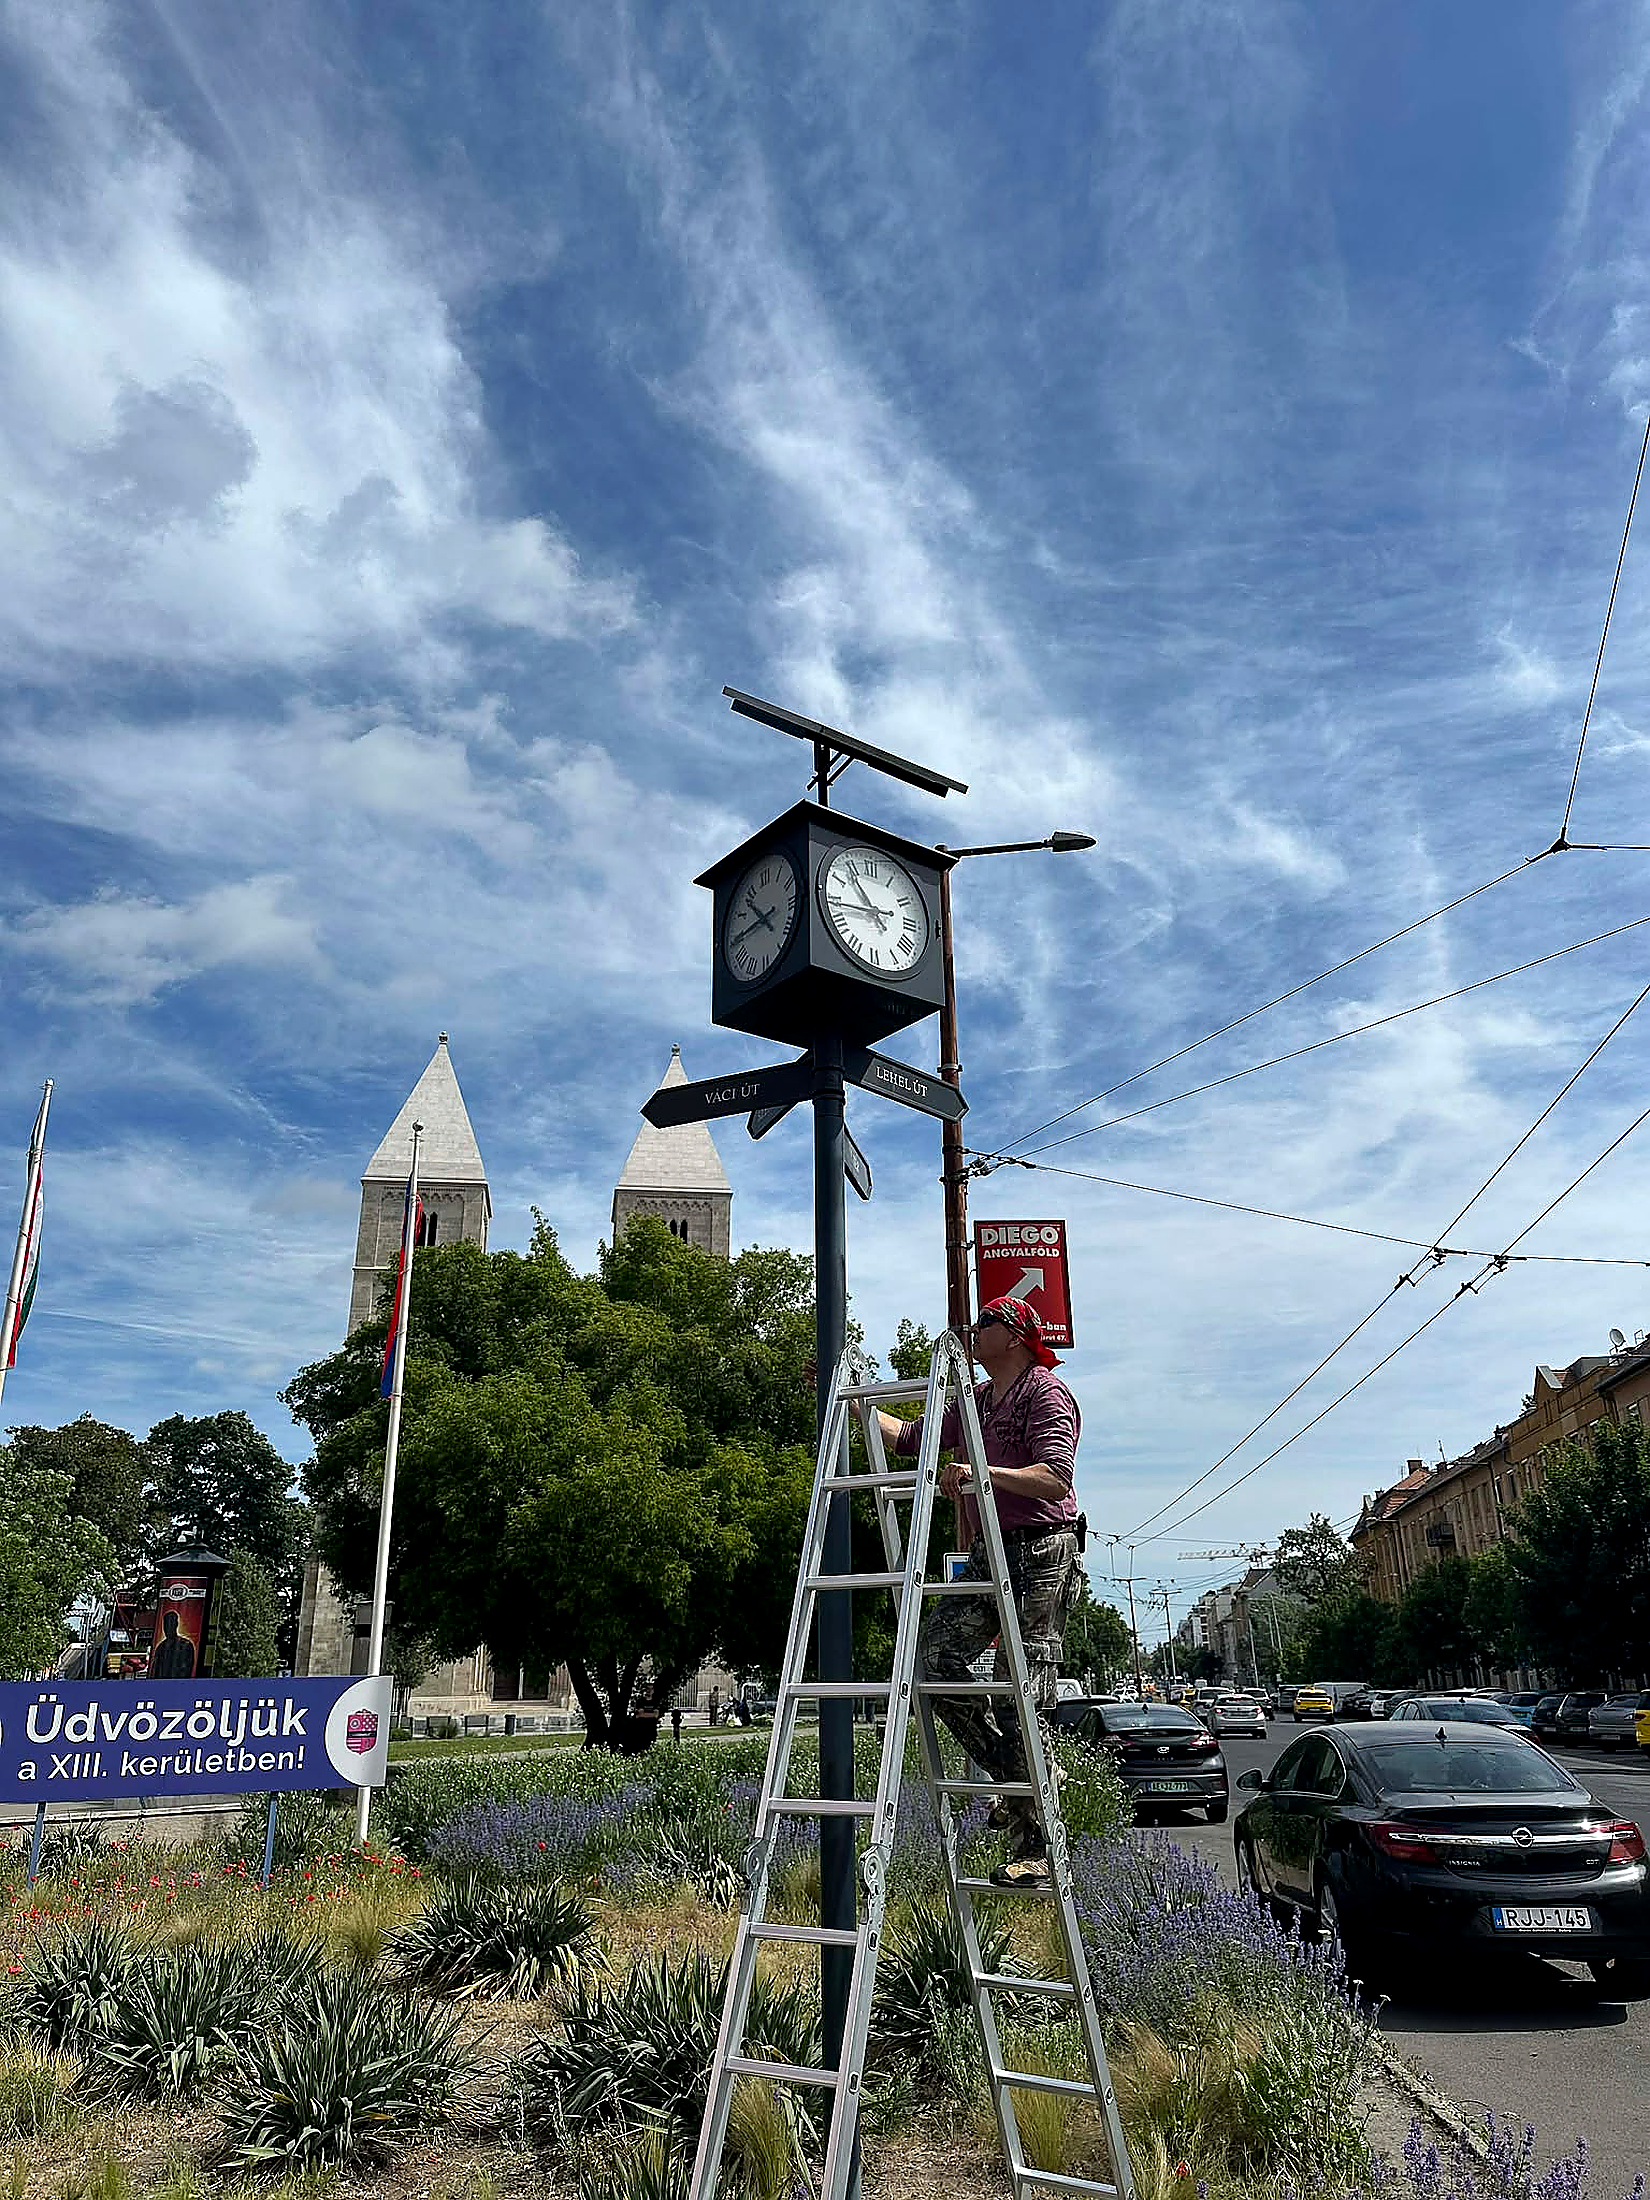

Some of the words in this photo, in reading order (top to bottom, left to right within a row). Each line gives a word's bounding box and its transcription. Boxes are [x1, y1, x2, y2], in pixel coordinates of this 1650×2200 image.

[902, 916, 918, 933] III
[875, 1066, 912, 1091] LEHEL
[912, 1079, 928, 1097] ÚT
[704, 1087, 736, 1104] VÁCI
[741, 1082, 760, 1098] ÚT
[980, 1226, 1059, 1246] DIEGO
[982, 1245, 1060, 1259] ANGYALFÖLD
[1041, 1321, 1067, 1331] -ban
[26, 1693, 310, 1747] Üdvözöljük
[17, 1759, 37, 1780] a
[47, 1752, 109, 1779] XIII.
[120, 1744, 306, 1778] kerületben!
[1505, 1908, 1587, 1927] RJJ-145
